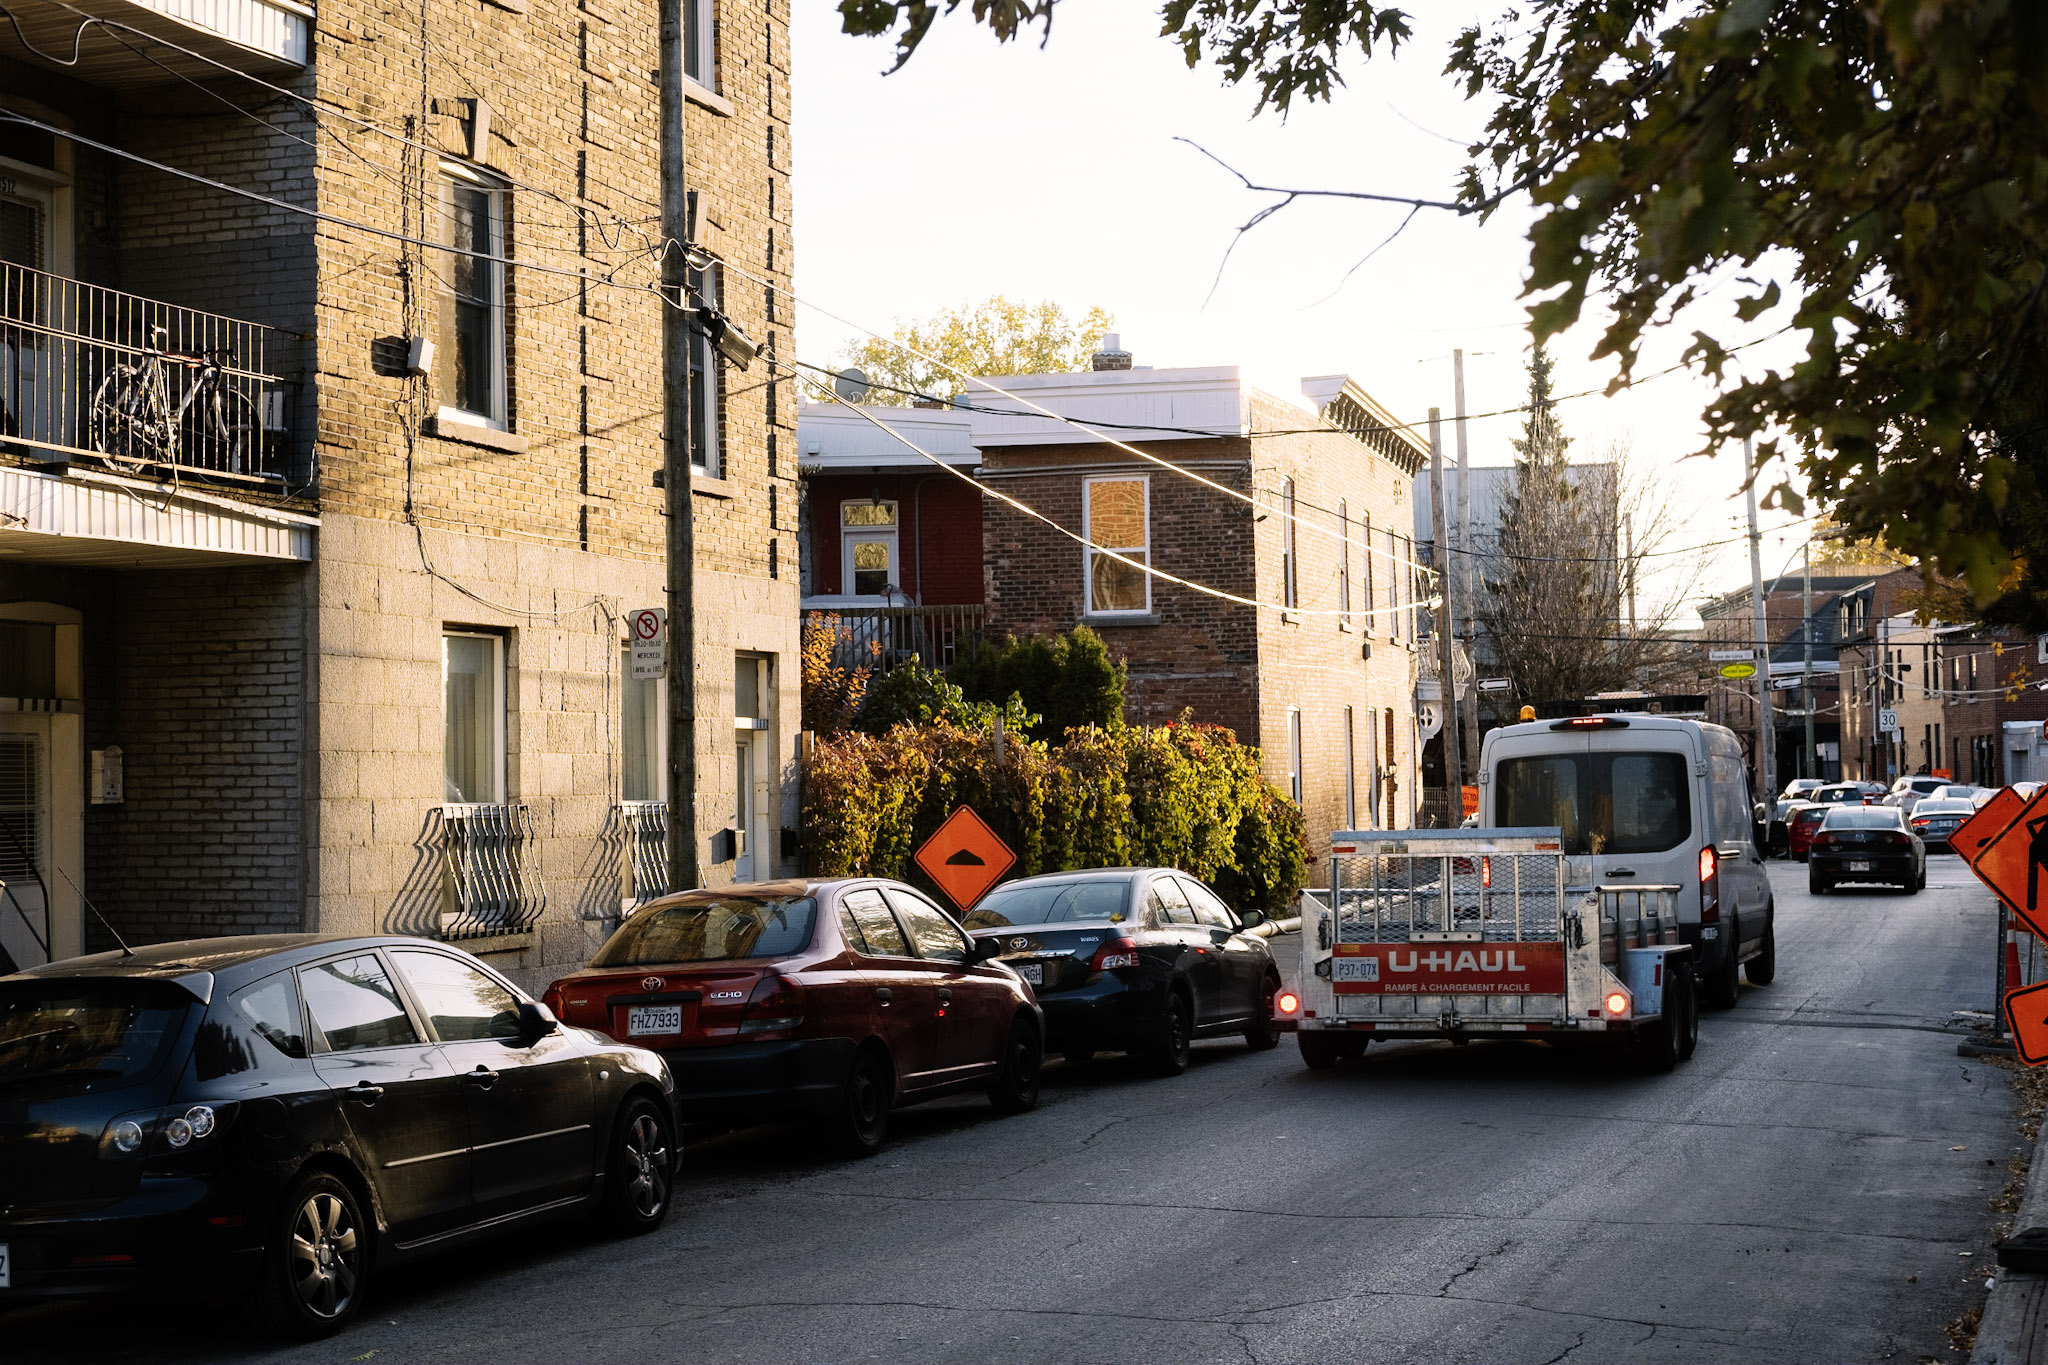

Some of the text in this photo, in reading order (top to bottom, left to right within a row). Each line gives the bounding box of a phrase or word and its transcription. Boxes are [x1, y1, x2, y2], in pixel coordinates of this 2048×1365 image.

[1882, 714, 1896, 726] 30
[1389, 951, 1526, 972] U-HAUL
[1339, 963, 1356, 976] P37
[1360, 963, 1377, 976] 07X
[1385, 982, 1531, 992] RAMPE À CHARGEMENT FACILE
[630, 1012, 679, 1029] FHZ7933
